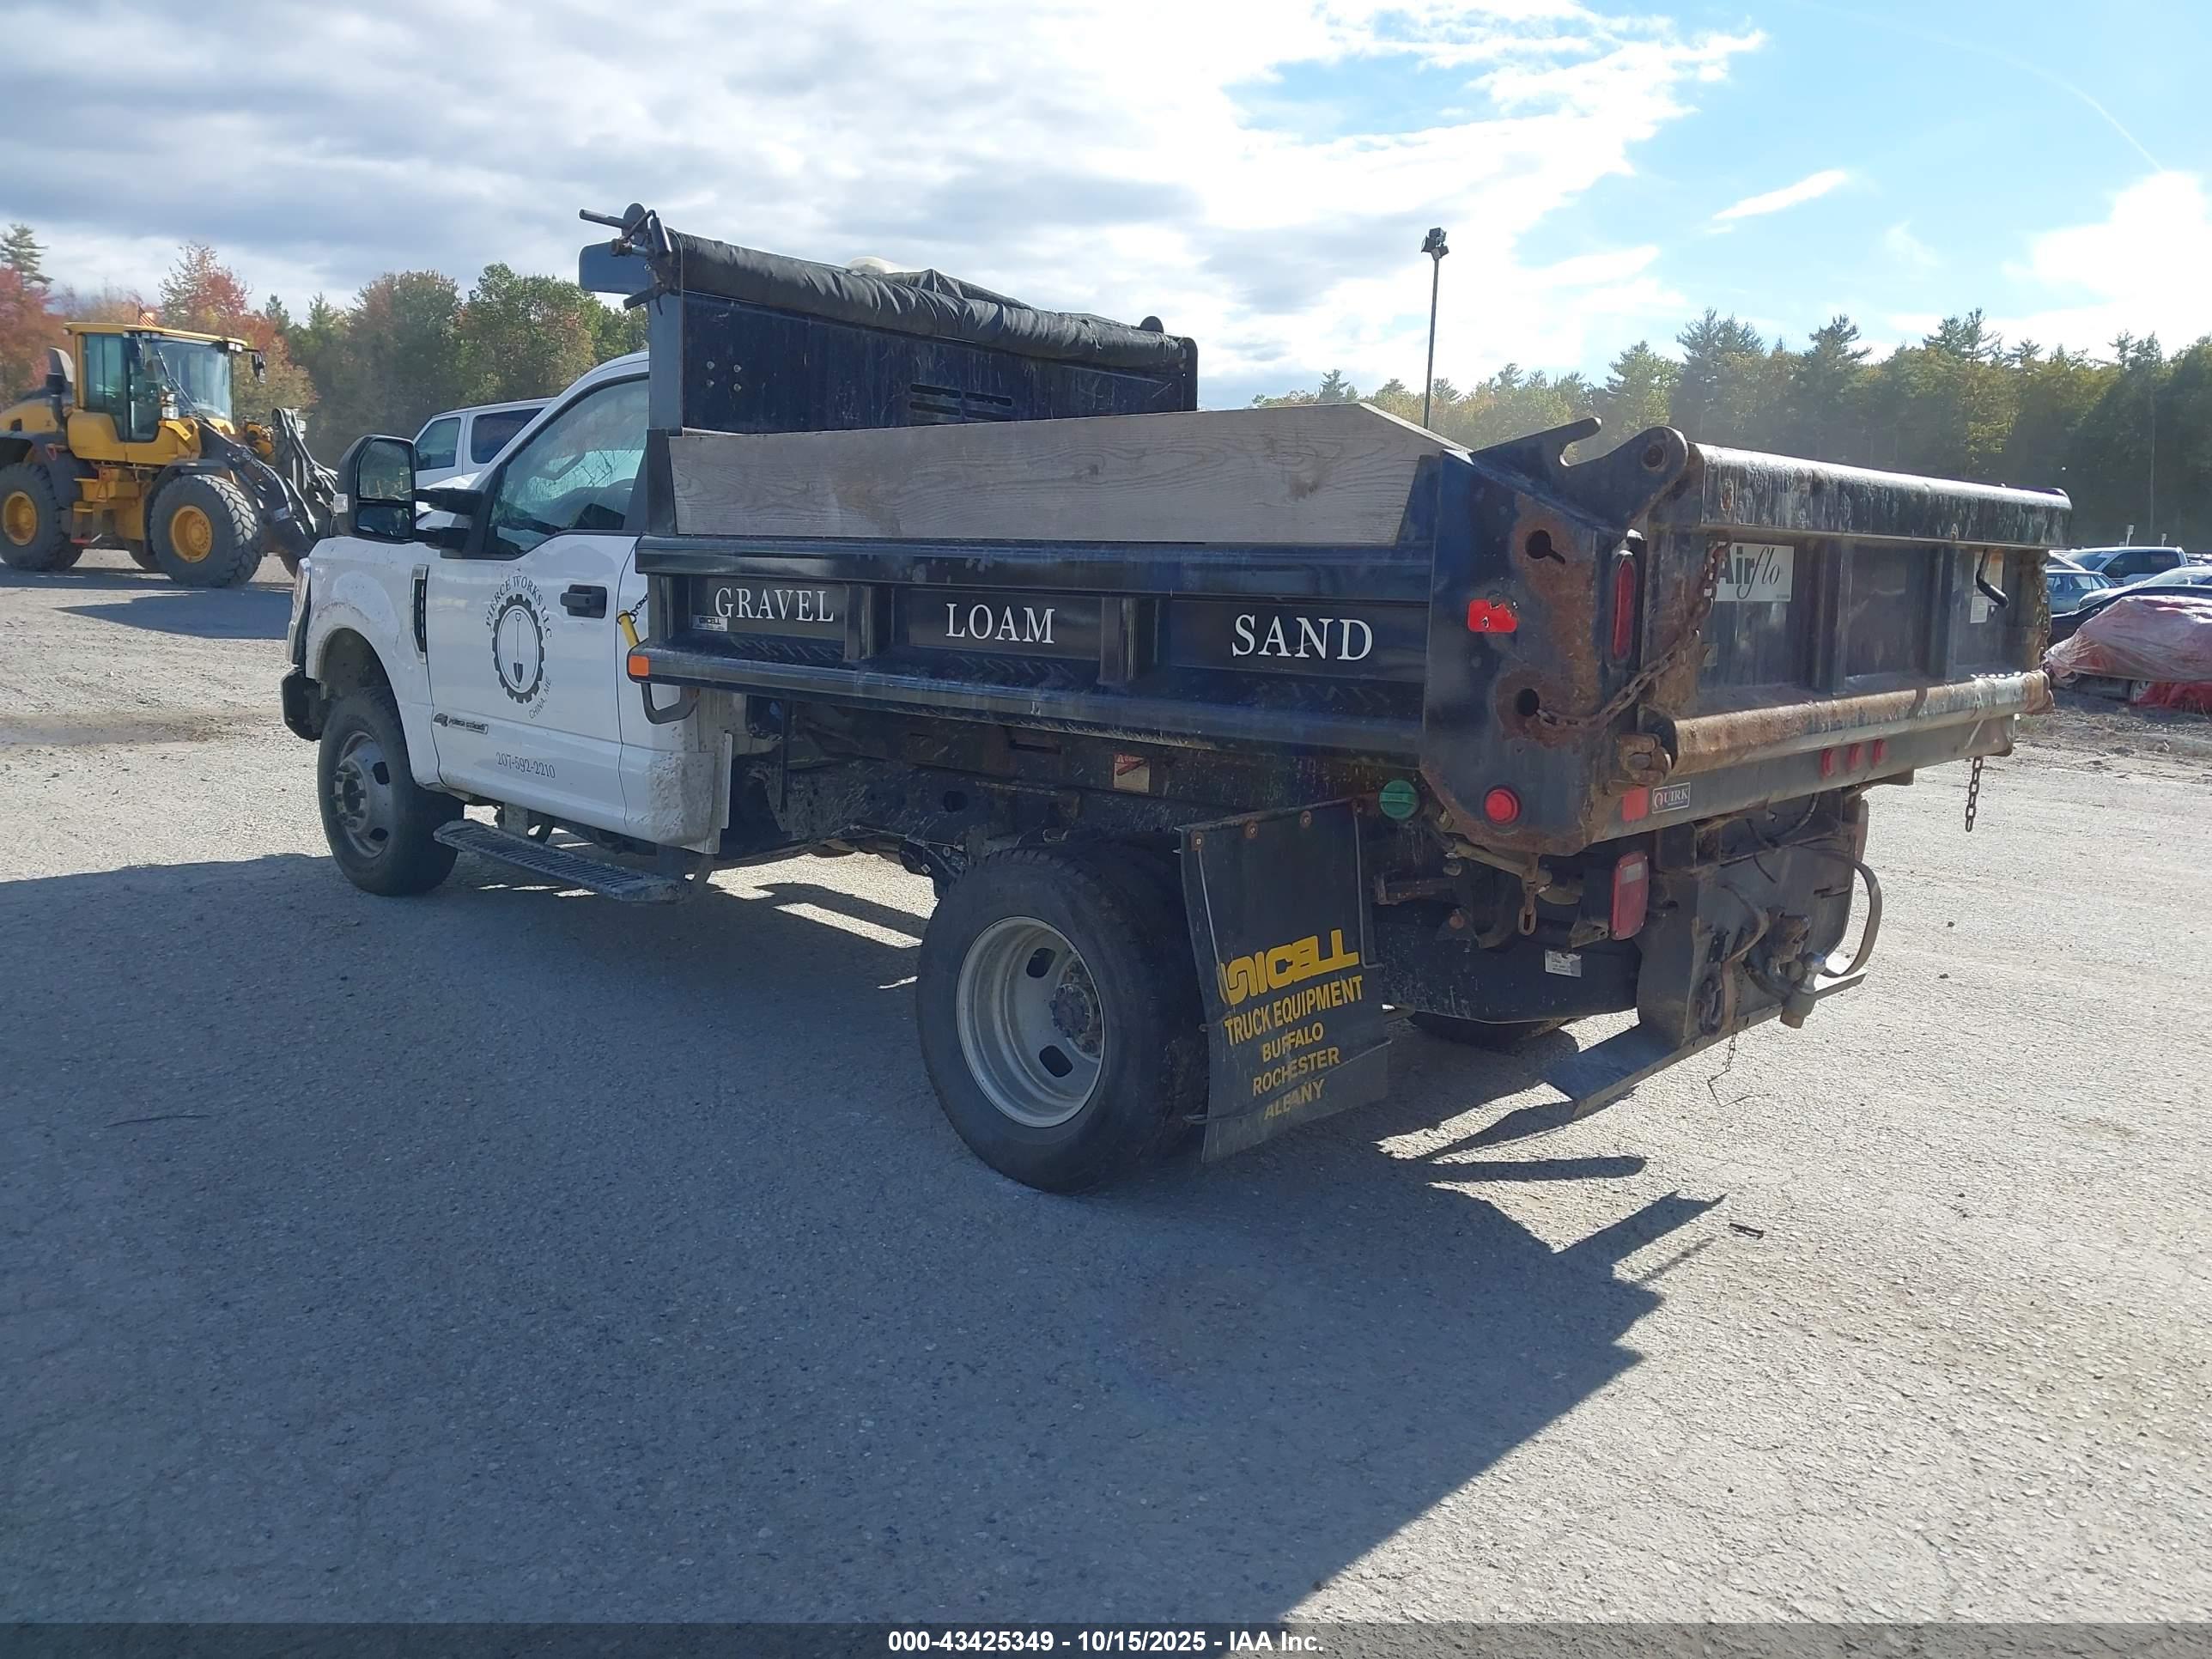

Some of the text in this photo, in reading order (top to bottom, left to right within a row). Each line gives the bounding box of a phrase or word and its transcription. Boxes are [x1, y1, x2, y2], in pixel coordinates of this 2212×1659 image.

[1717, 546, 1780, 599] Airflo
[486, 575, 552, 639] PIERCE WORKS LLC
[714, 587, 834, 622] GRAVEL
[945, 603, 1055, 643] LOAM
[1231, 614, 1373, 660] SAND
[544, 676, 551, 695] ME
[495, 751, 556, 779] 207-592-2210
[1655, 789, 1688, 808] QUIRK
[1224, 975, 1363, 1046] TRUCK EQUIPMENT
[1262, 1022, 1324, 1063] BUFFALO
[1253, 1047, 1340, 1097] ROCHESTER
[1264, 1079, 1325, 1121] ALBANY
